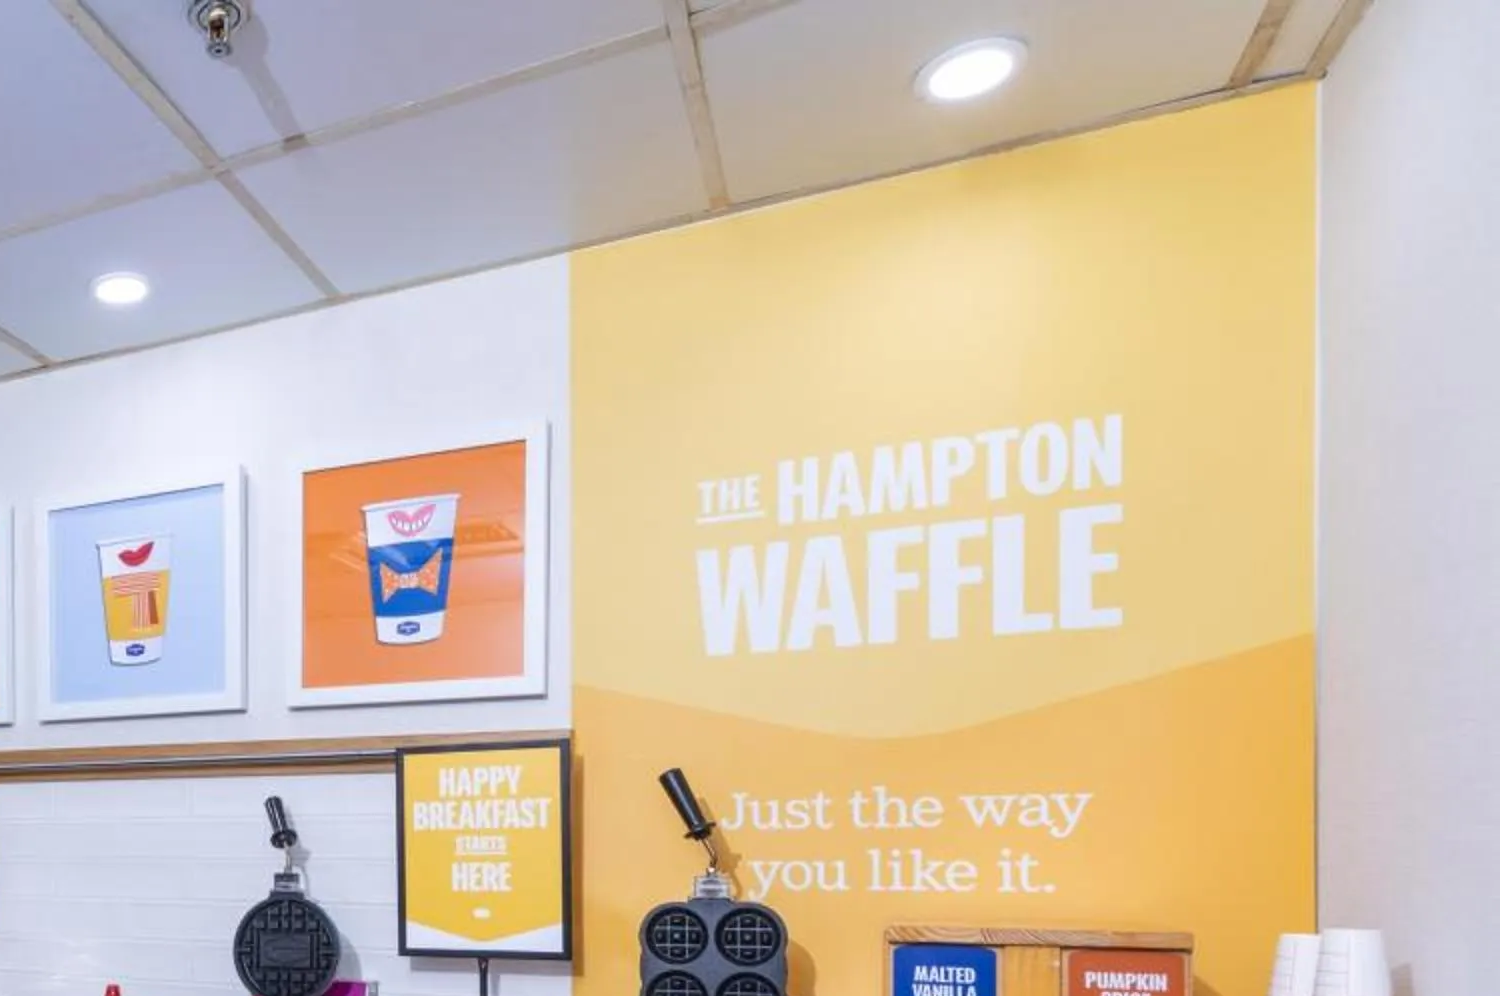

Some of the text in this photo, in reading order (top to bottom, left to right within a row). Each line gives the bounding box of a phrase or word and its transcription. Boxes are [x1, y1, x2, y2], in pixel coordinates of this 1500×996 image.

[698, 413, 1123, 526] THE HAMPTON
[695, 503, 1124, 656] WAFFLE
[438, 766, 522, 797] HAPPY
[413, 798, 552, 831] BREAKFAST
[720, 785, 1095, 839] Just the way
[451, 862, 512, 892] HERE
[747, 848, 1058, 900] you like it.
[914, 965, 976, 985] MALTED
[1084, 970, 1168, 992] PUMPKIN
